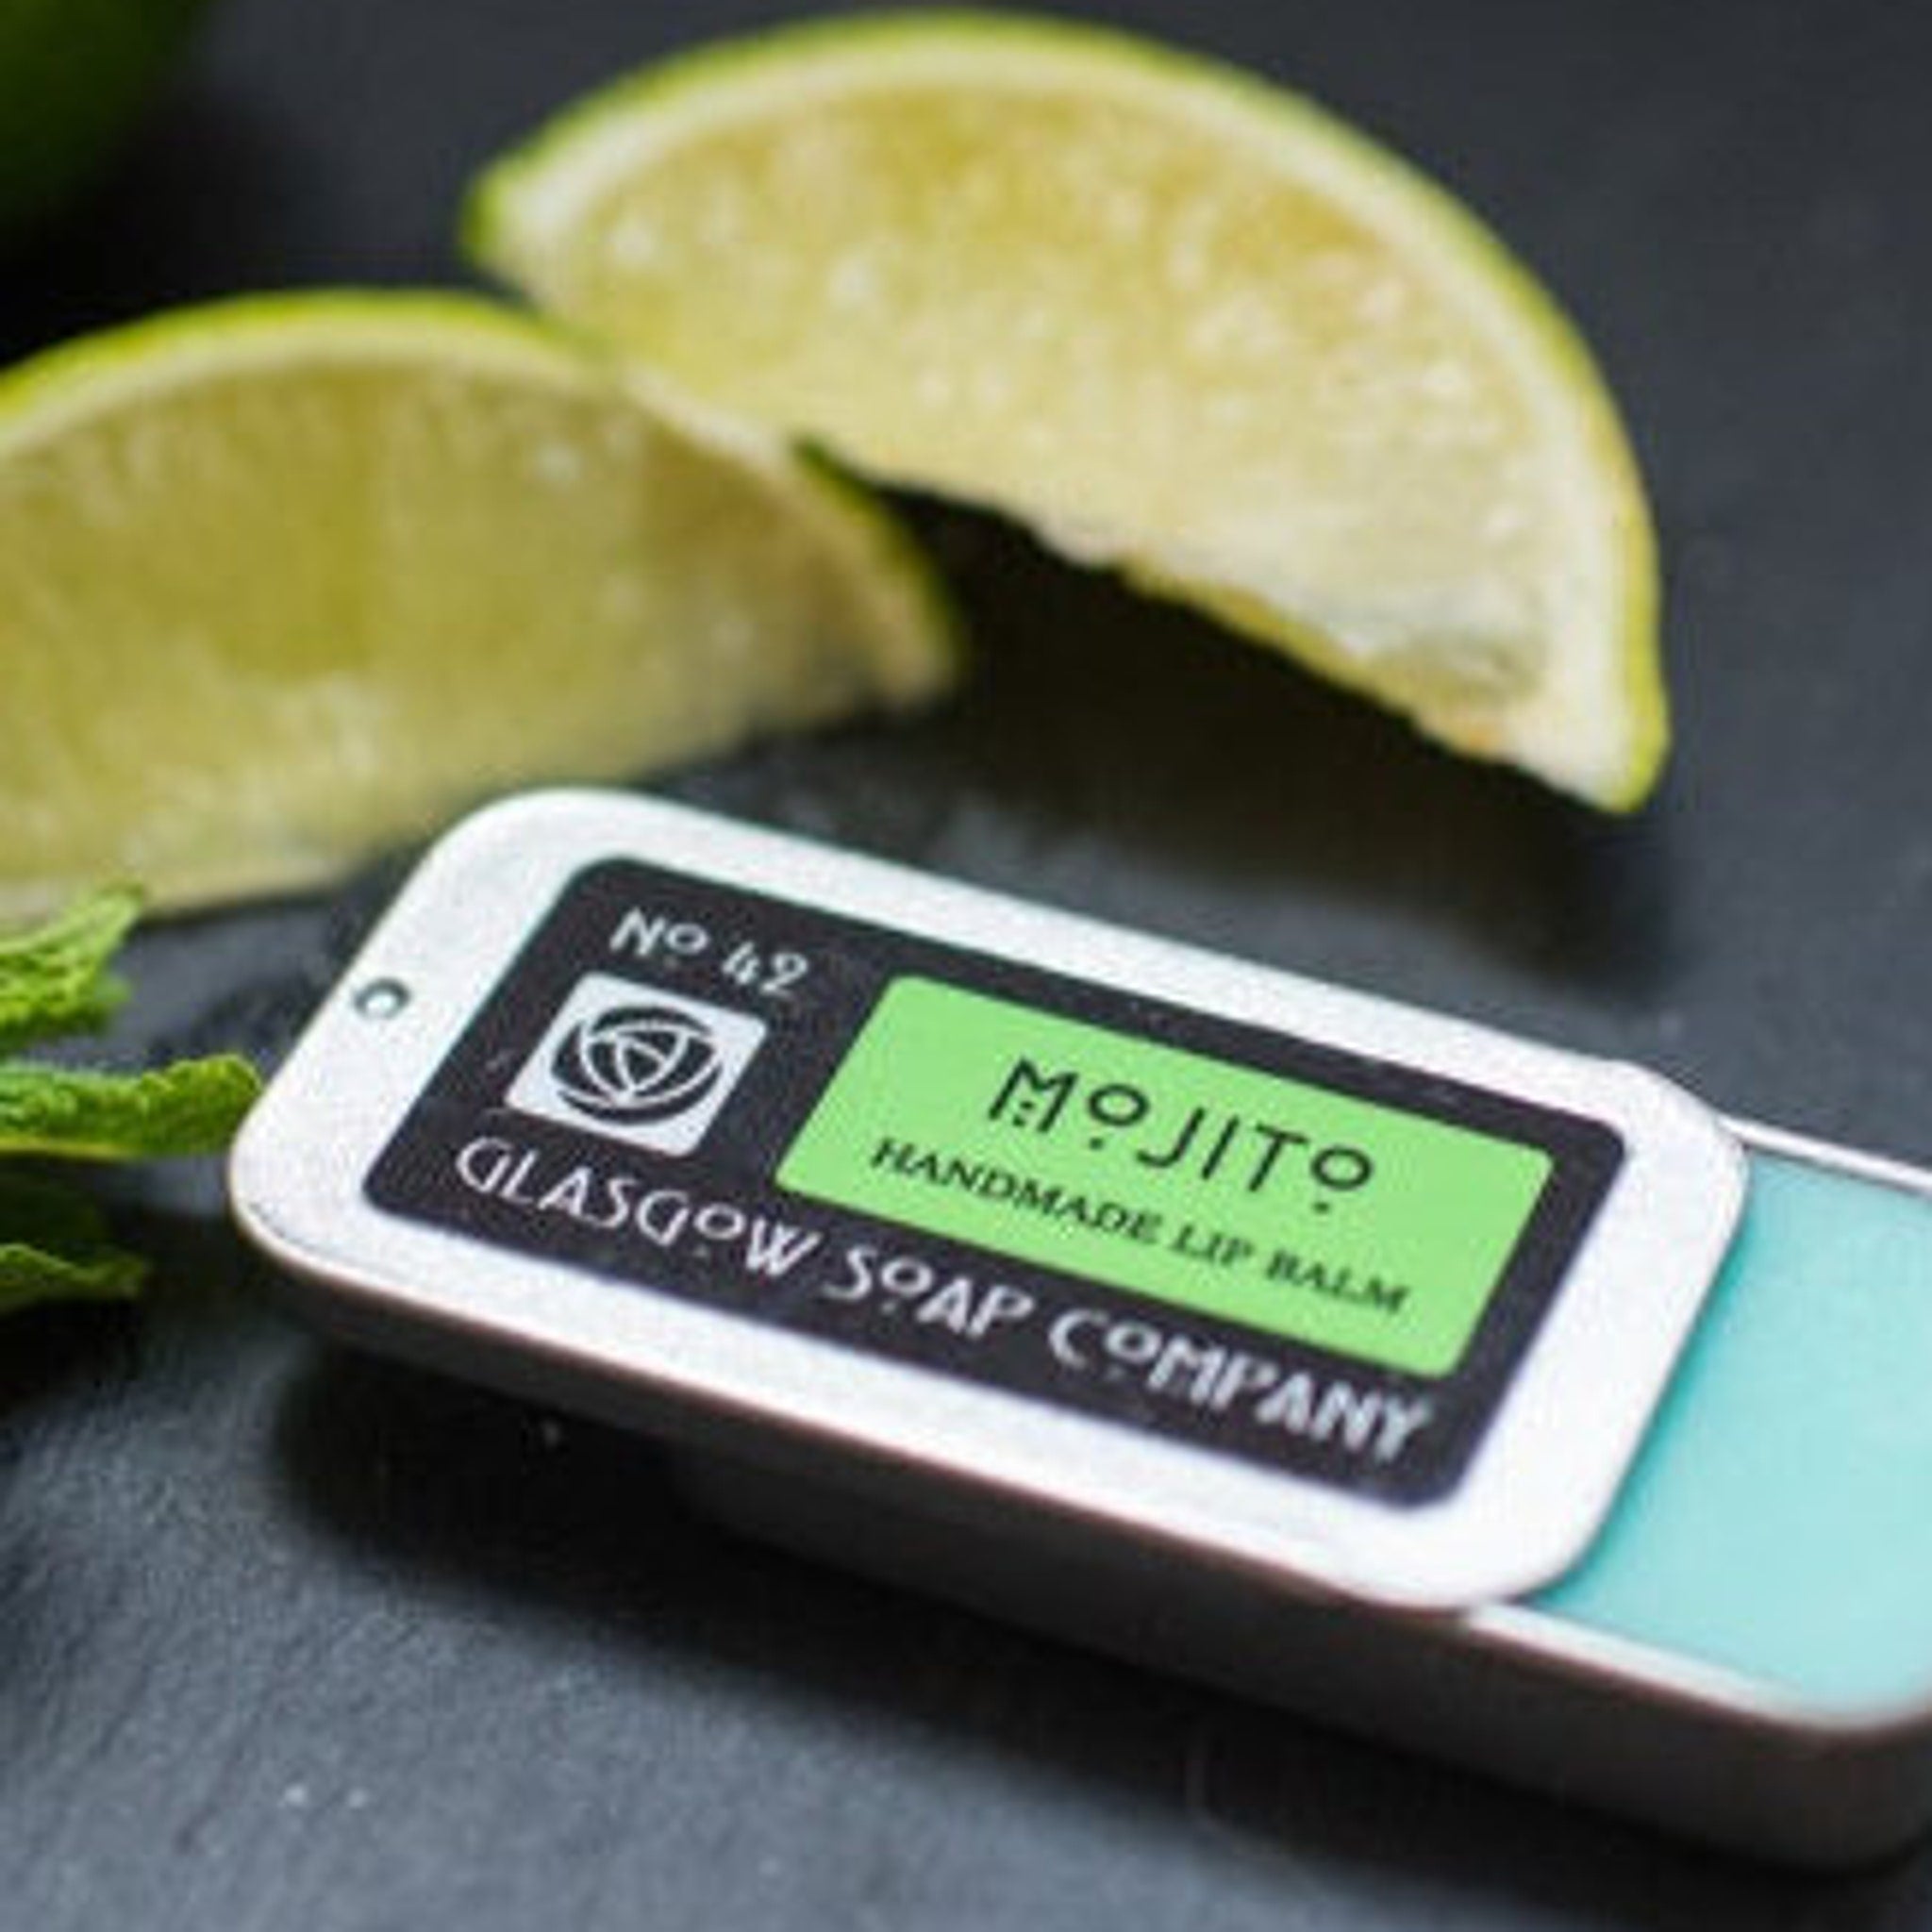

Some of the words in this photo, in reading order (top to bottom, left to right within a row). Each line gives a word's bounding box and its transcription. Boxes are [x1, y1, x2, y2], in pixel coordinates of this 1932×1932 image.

[721, 941, 808, 1000] 42
[989, 1056, 1374, 1213] MOJITO
[455, 1136, 823, 1276] GLASGOW
[822, 1243, 1034, 1340] SOAP
[1048, 1308, 1432, 1462] COMPANY
[870, 1138, 1163, 1241] HANDMADE
[1171, 1226, 1256, 1269] LIP
[1266, 1254, 1410, 1312] BALM
